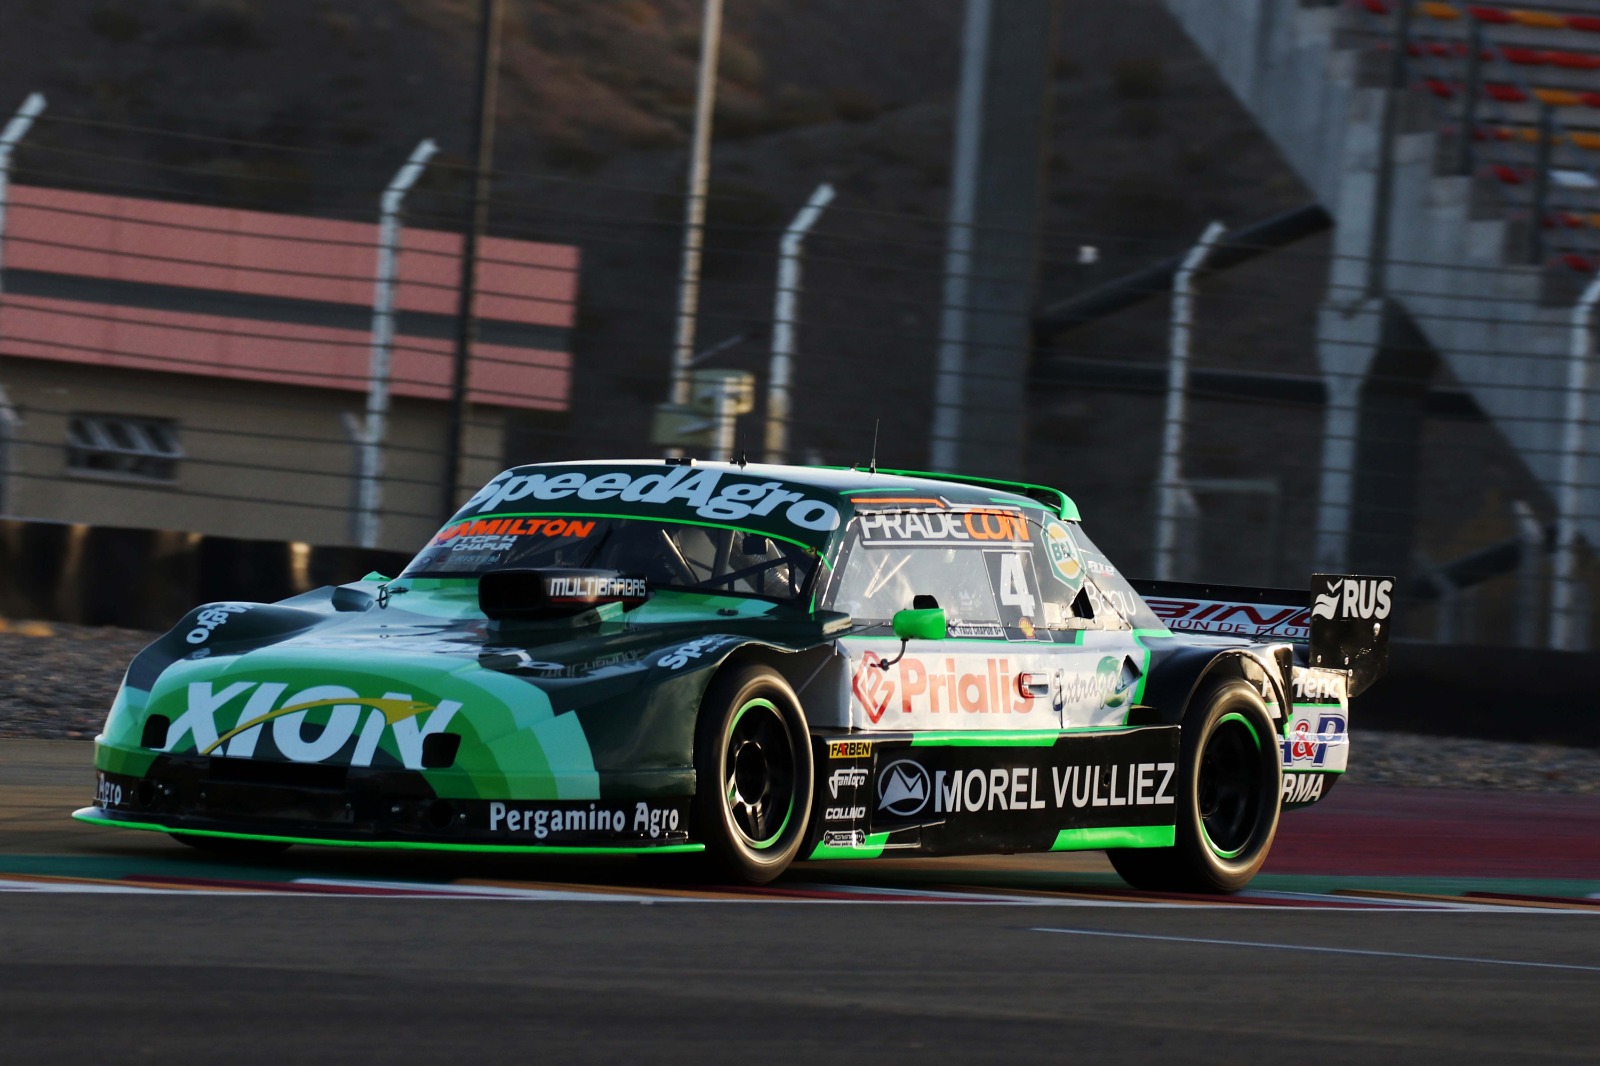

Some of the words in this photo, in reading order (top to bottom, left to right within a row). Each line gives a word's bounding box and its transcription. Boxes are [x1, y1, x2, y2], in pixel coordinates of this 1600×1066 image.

[461, 467, 841, 532] SpeedAgro
[859, 507, 1030, 541] PRADECON
[452, 543, 513, 551] CHAPUR
[1000, 553, 1035, 617] 4
[1342, 580, 1393, 620] RUS
[1218, 623, 1250, 633] DE
[898, 657, 1035, 714] Prialis
[163, 681, 464, 770] XION
[831, 742, 871, 757] FARBEN
[934, 767, 1046, 813] MOREL
[1052, 762, 1175, 808] VULLIEZ
[490, 802, 626, 839] Pergamino
[633, 802, 679, 838] Agro
